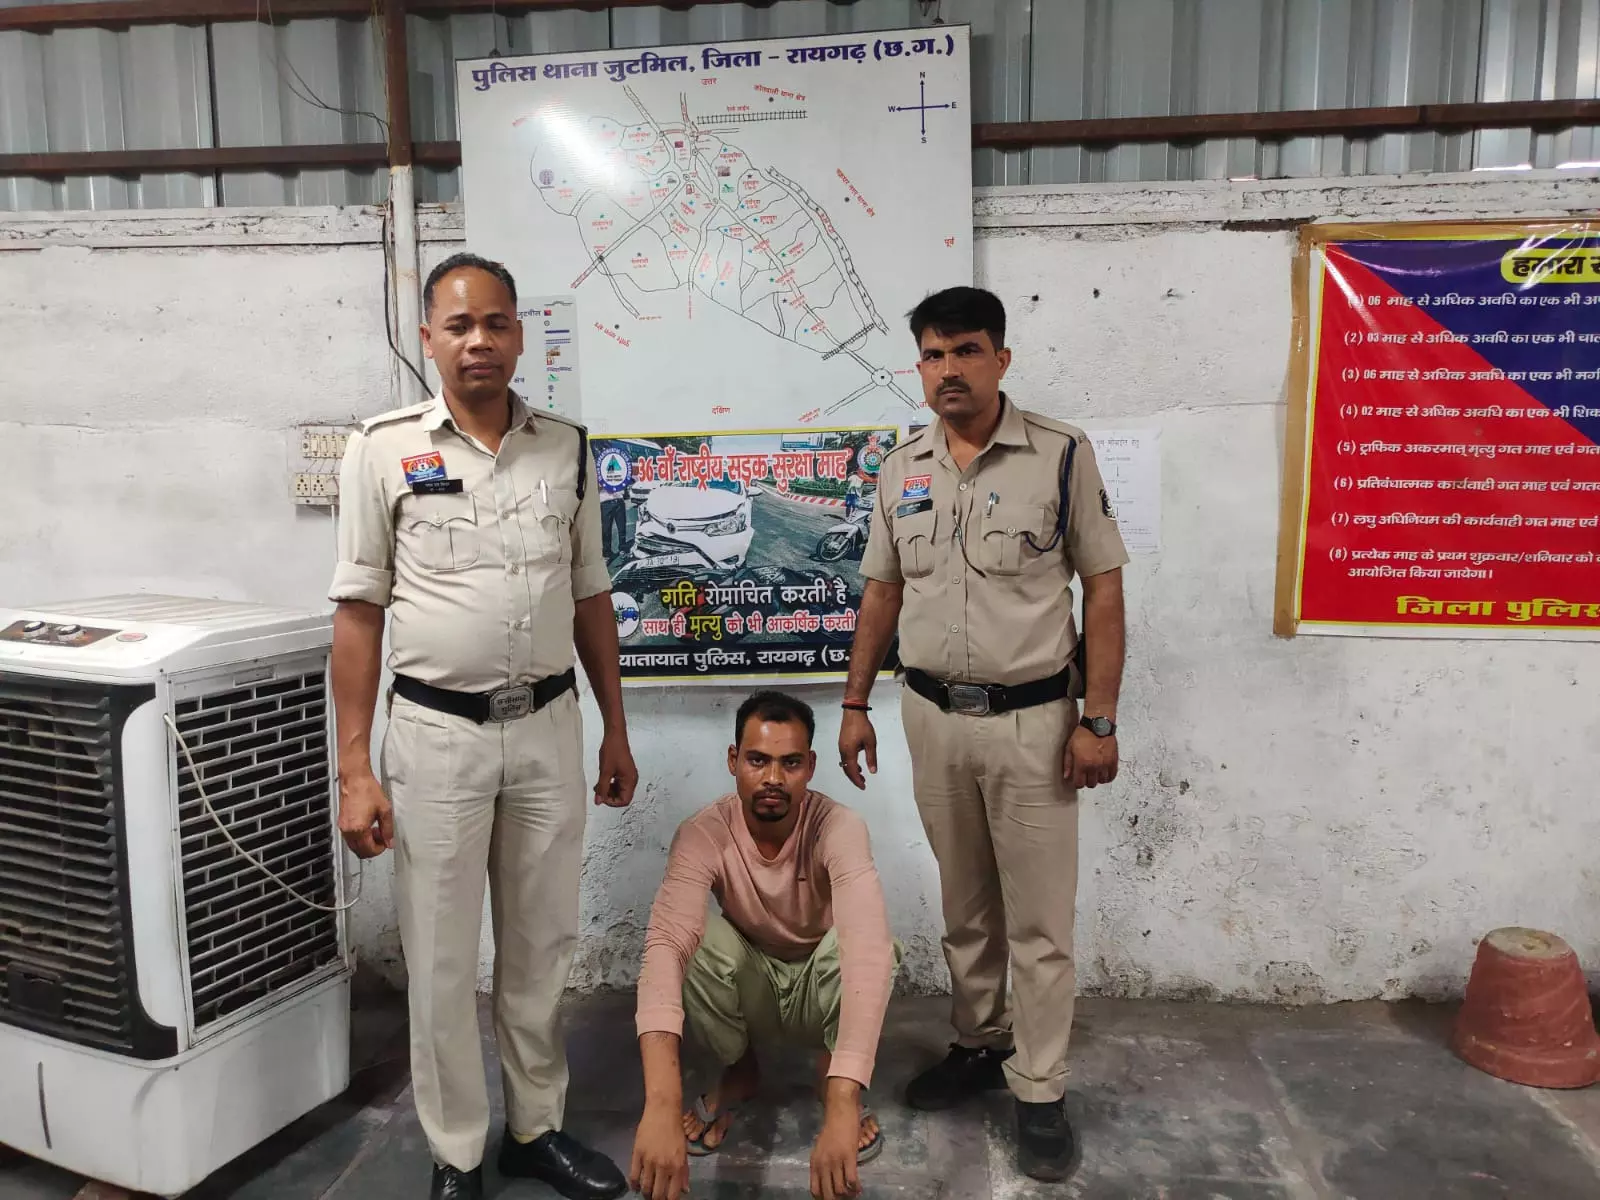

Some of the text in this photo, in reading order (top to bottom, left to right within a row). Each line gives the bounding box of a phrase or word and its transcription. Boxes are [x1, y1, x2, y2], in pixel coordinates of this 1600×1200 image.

[471, 62, 536, 91] पुलिस
[543, 62, 598, 79] थाना
[603, 52, 695, 82] जुटमिल,
[702, 48, 761, 69] जिला
[787, 44, 866, 63] रायगढ़
[874, 35, 954, 60] (छ.ग.)
[701, 77, 717, 85] उत्तर
[1368, 295, 1381, 305] 06
[1387, 296, 1413, 306] माह
[1417, 293, 1430, 305] से
[1432, 292, 1475, 305] अधिक
[1478, 292, 1516, 305] अवधि
[1519, 297, 1537, 305] का
[1539, 297, 1560, 306] एक
[1563, 292, 1580, 305] भी
[1344, 330, 1363, 345] (2)
[1381, 334, 1407, 344] माह
[1411, 331, 1424, 343] से
[1425, 330, 1469, 343] अधिक
[1472, 330, 1508, 343] अवधि
[1511, 334, 1530, 343] का
[1531, 334, 1555, 344] एक
[1558, 330, 1575, 343] भी
[1341, 367, 1360, 382] (3)
[1363, 369, 1377, 380] 06
[1379, 370, 1406, 380] माह
[1407, 368, 1420, 380] से
[1422, 367, 1466, 380] अधिक
[1468, 368, 1505, 380] अवधि
[1507, 371, 1526, 380] का
[1529, 371, 1553, 381] एक
[1555, 368, 1572, 380] भी
[711, 405, 731, 414] दक्षिण
[1340, 403, 1358, 419] (4)
[1361, 406, 1374, 416] 02
[1375, 407, 1403, 417] माह
[1405, 405, 1419, 417] से
[1421, 404, 1461, 417] अधिक
[1463, 405, 1503, 417] अवधि
[1505, 408, 1525, 417] का
[1526, 408, 1550, 418] एक
[1552, 405, 1570, 417] भी
[1337, 440, 1356, 455] (5)
[1360, 440, 1402, 455] ट्राफिक
[1468, 444, 1496, 458] मृत्यु
[1498, 445, 1523, 454] गत
[1525, 445, 1552, 455] माह
[1554, 442, 1575, 455] एवं
[639, 457, 653, 482] 36
[679, 443, 723, 490] राष्ट्रीय
[772, 453, 814, 493] सुरक्षा
[817, 451, 848, 480] माह
[1334, 476, 1353, 491] (6)
[1357, 476, 1434, 489] प्रतिबंधात्मक
[1437, 477, 1495, 490] कार्यवाही
[1498, 481, 1520, 490] गत
[1522, 481, 1547, 491] माह
[1550, 479, 1571, 490] एवं
[1331, 512, 1598, 528] (7) लघु अधिनियम की कार्यवाही गत माह एवं
[1329, 547, 1348, 561] (8)
[1351, 548, 1390, 560] प्रत्येक
[1393, 551, 1418, 560] माह
[1421, 549, 1434, 560] के
[1437, 552, 1466, 561] प्रथम
[1575, 552, 1593, 563] को
[1348, 566, 1406, 578] आयोजित
[1409, 566, 1441, 578] किया
[661, 578, 847, 606] गति रोमांचित करती है
[1397, 596, 1496, 616] जिला
[643, 618, 668, 635] साथ
[671, 613, 685, 635] ही
[689, 615, 721, 640] मृत्यु
[726, 613, 744, 634] को
[747, 612, 762, 633] भी
[823, 609, 855, 632] करती
[619, 653, 689, 666] यातायात
[694, 648, 750, 671] पुलिस,
[757, 650, 816, 667] रायगढ़
